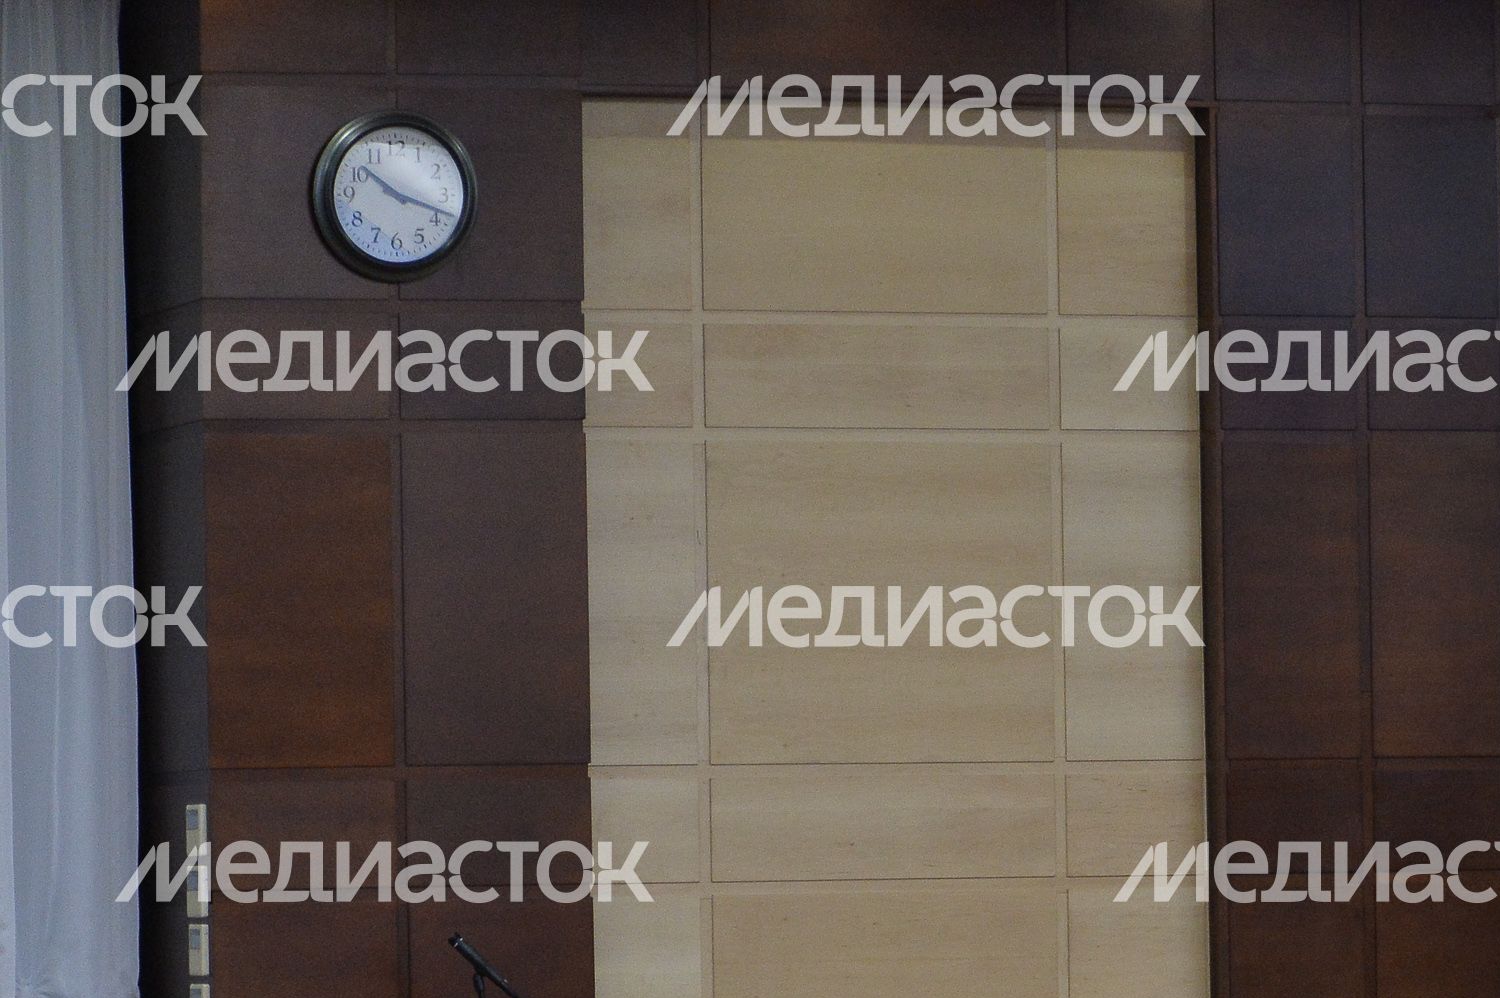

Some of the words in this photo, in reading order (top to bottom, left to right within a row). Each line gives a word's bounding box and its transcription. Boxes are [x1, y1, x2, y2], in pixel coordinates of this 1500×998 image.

[344, 186, 356, 204] 9
[352, 211, 363, 227] 8
[429, 211, 441, 227] 4
[370, 227, 382, 244] 7
[390, 232, 403, 250] 6
[414, 228, 425, 244] 5
